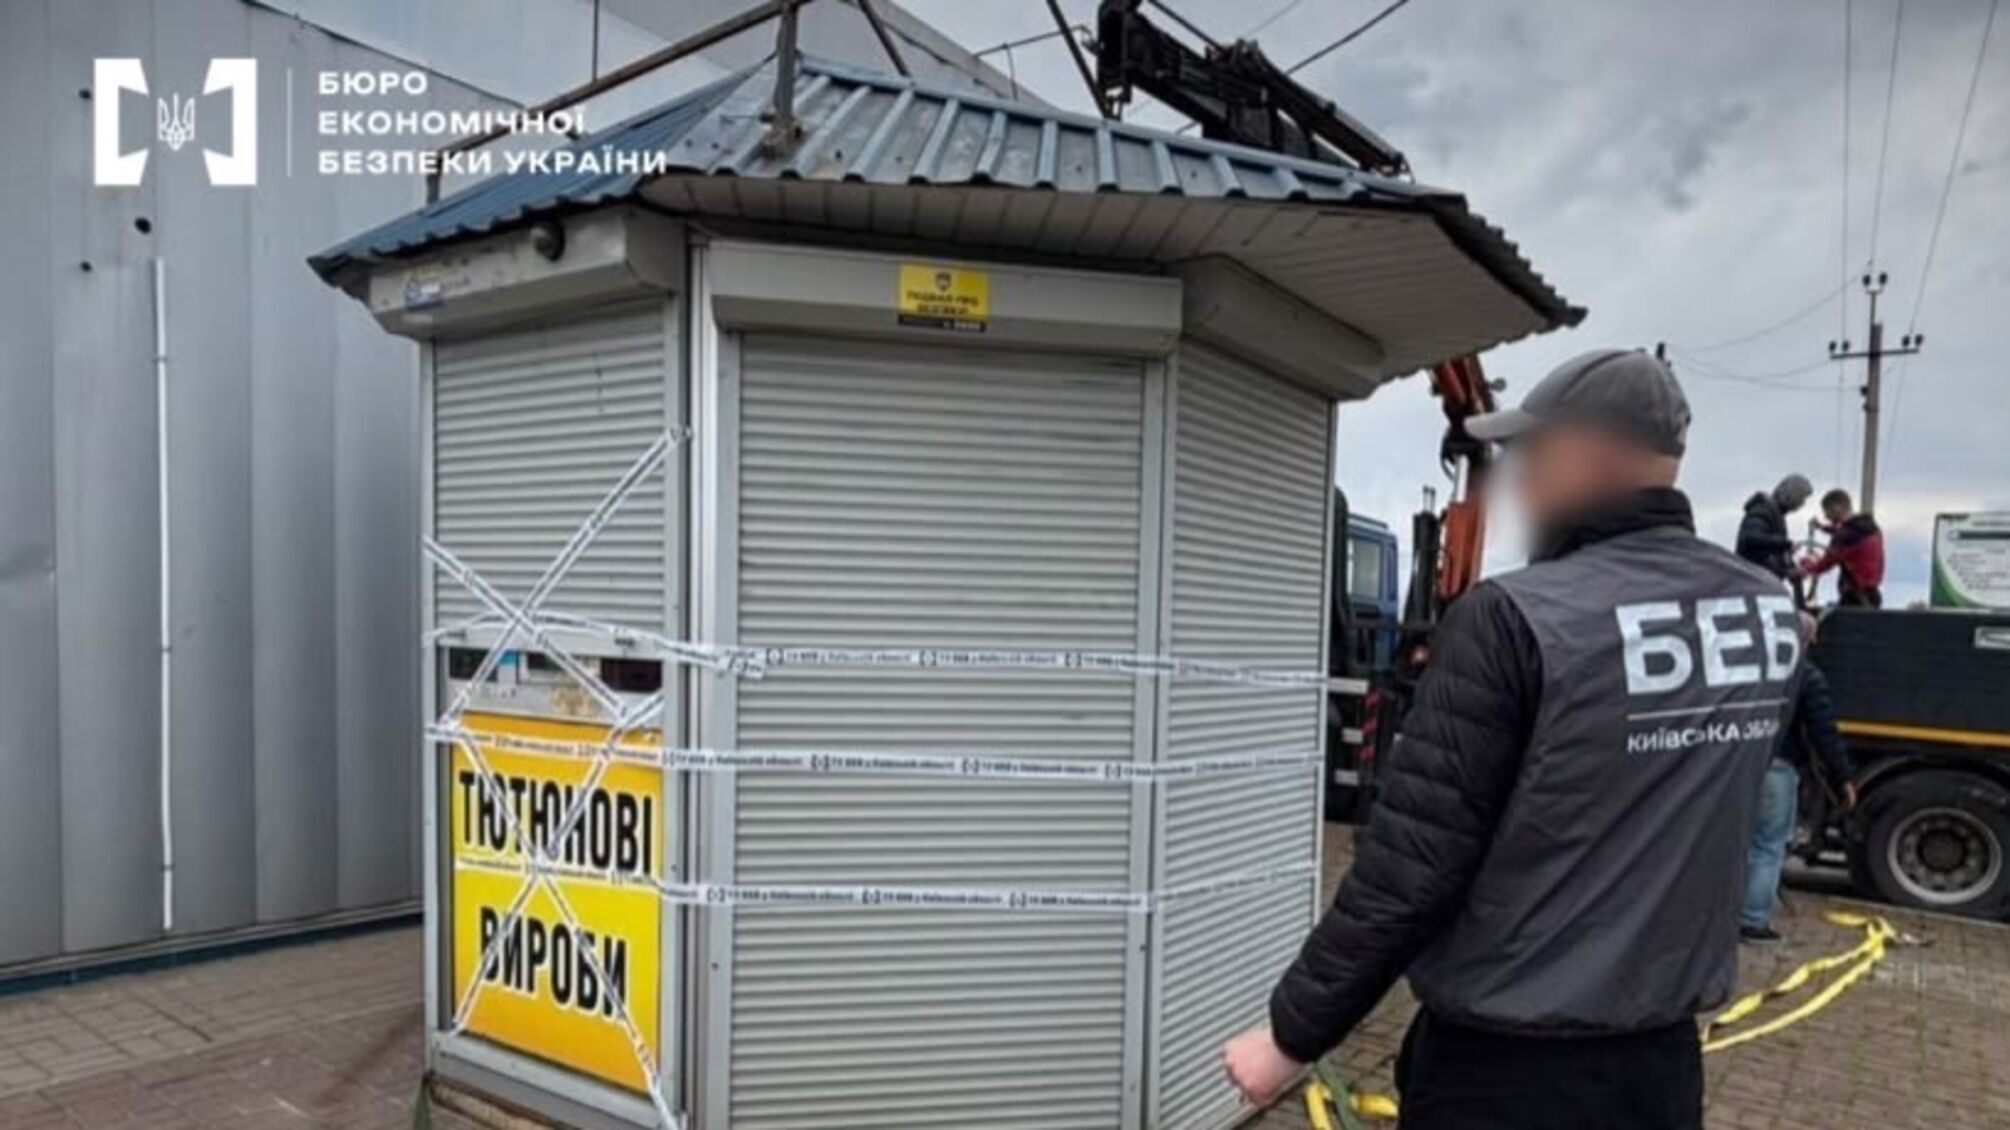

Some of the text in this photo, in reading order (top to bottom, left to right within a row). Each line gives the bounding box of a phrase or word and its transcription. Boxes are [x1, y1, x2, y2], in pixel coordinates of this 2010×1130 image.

[1615, 595, 1800, 695] БЕБ
[459, 770, 653, 876] ТЮТЮНОВІ
[480, 904, 627, 1018] ВИРОБИ
